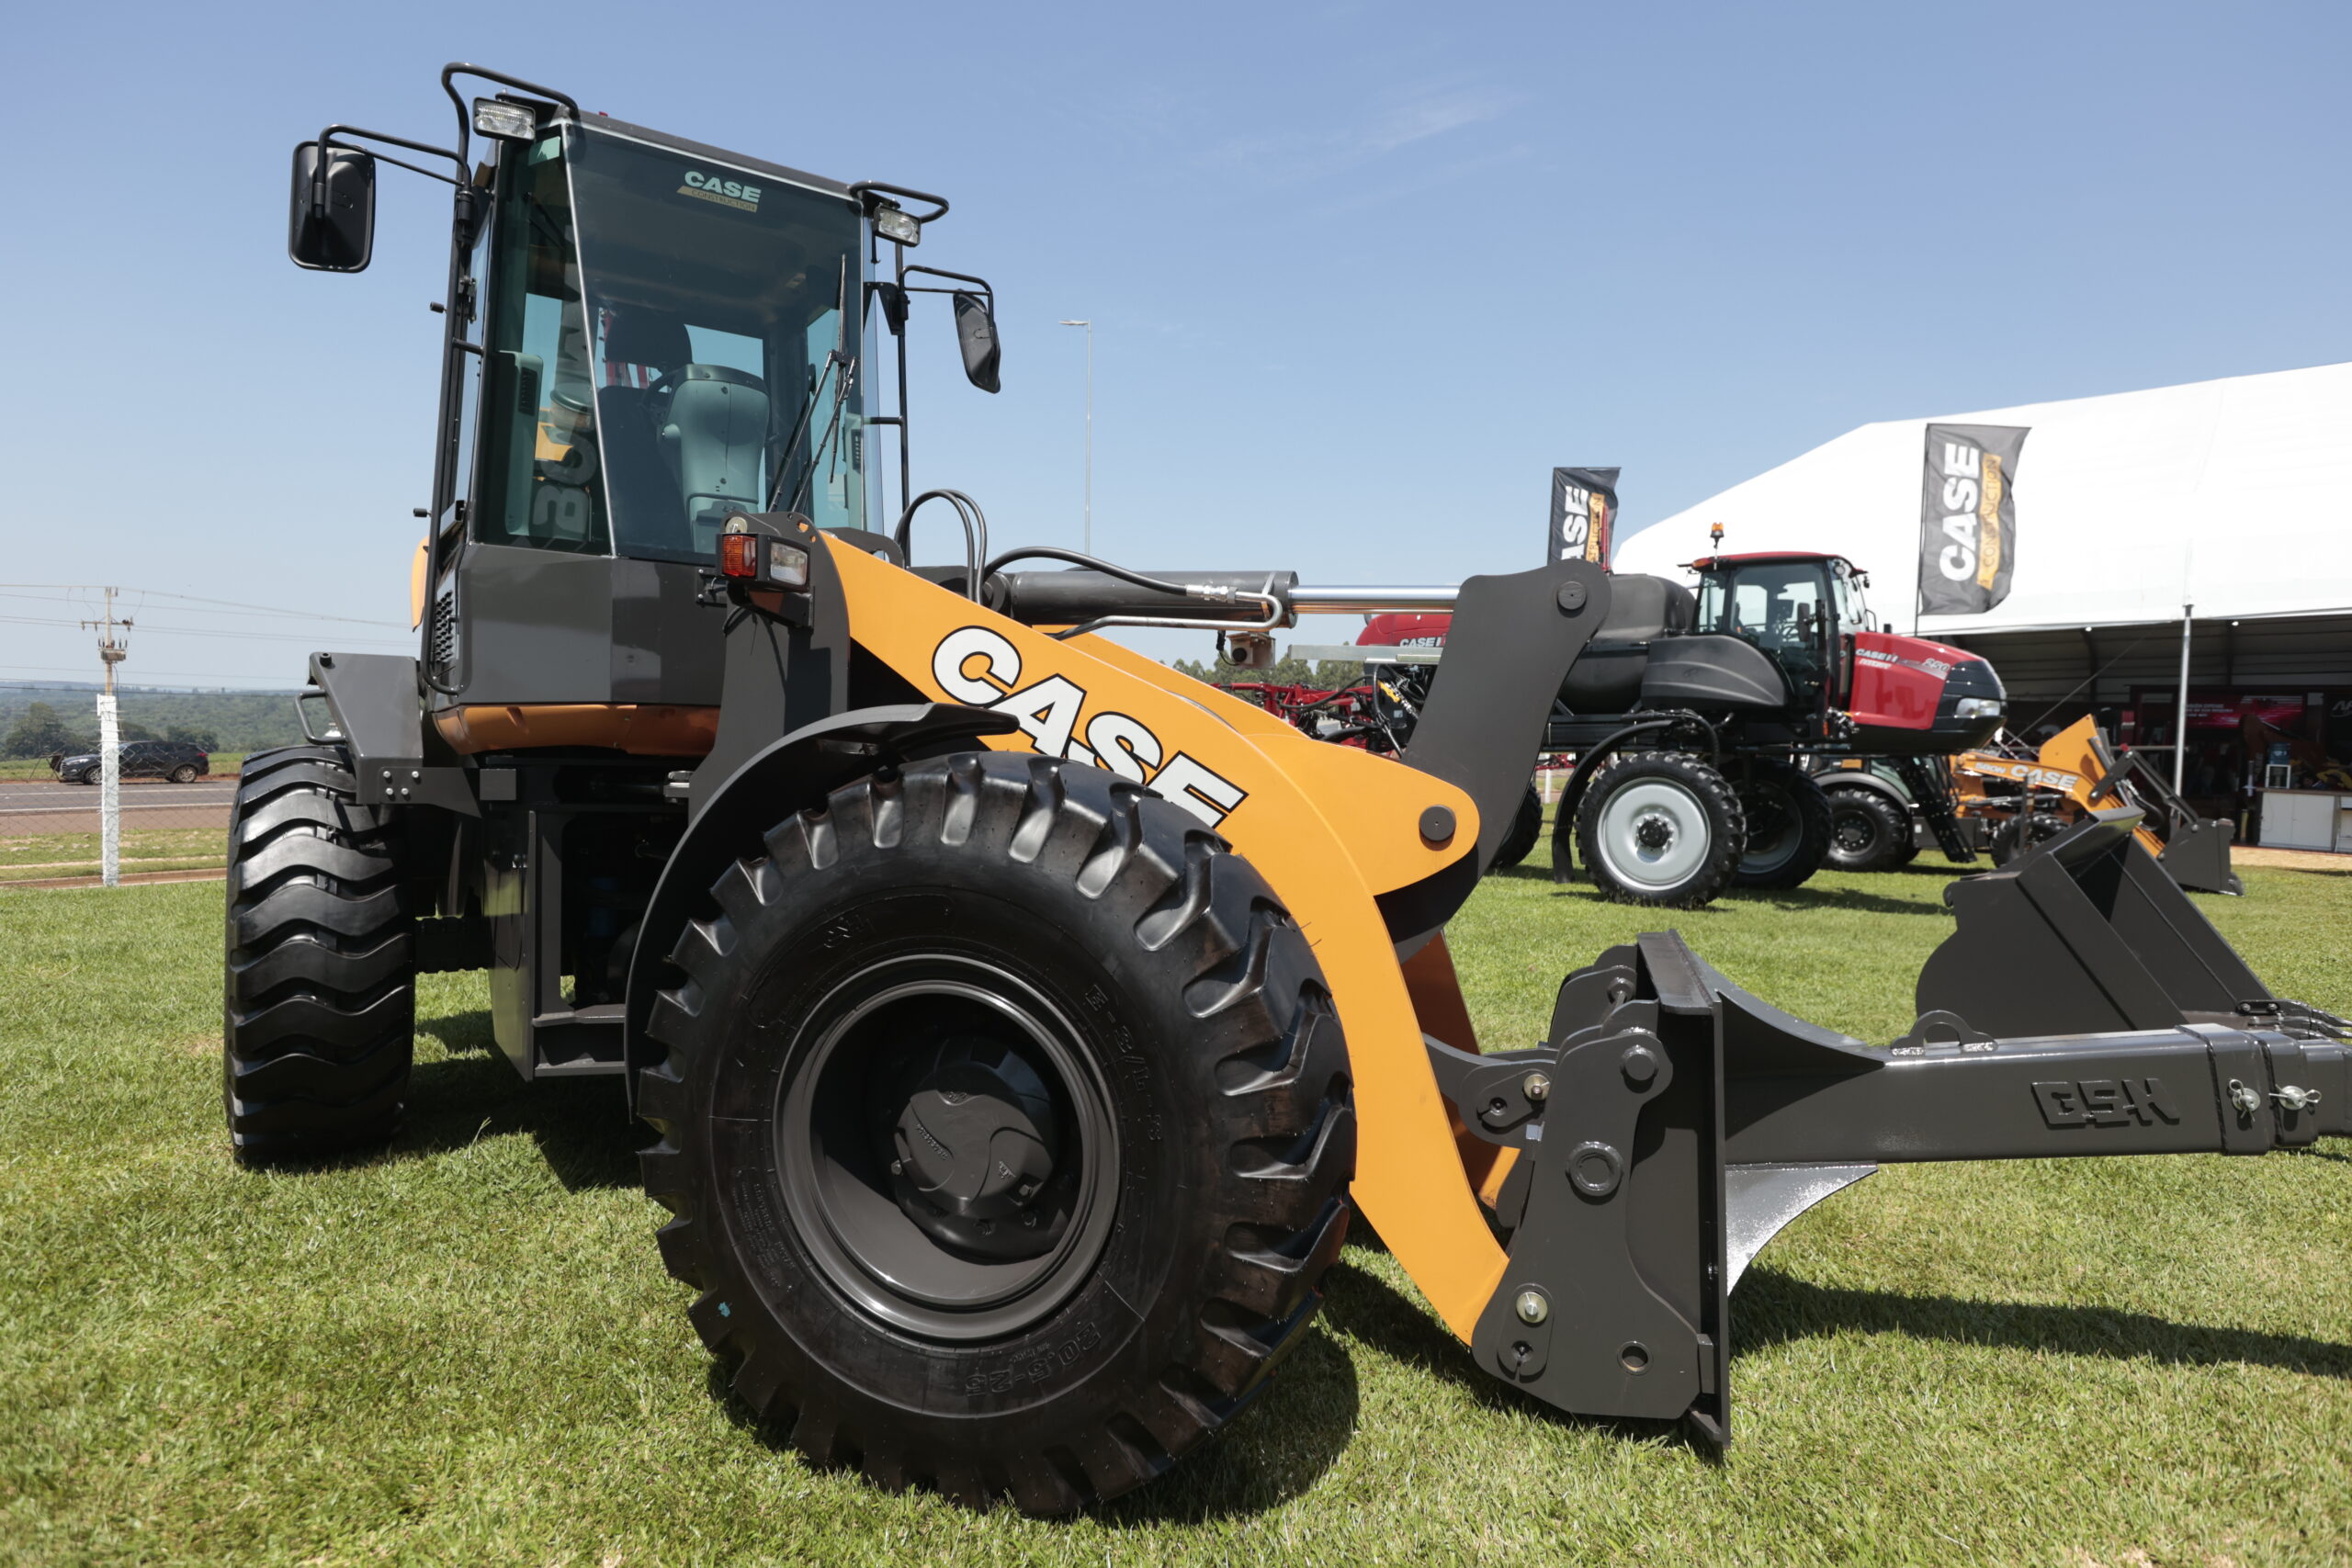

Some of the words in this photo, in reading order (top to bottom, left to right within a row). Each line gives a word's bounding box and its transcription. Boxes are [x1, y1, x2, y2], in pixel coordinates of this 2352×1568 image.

[684, 171, 762, 203] CASE
[691, 189, 756, 210] CONSTRUCTION
[1561, 485, 1589, 560] ASE
[1939, 443, 1980, 581] CASE
[1982, 458, 1999, 568] CONSTRUCTION
[1399, 637, 1436, 648] CASE
[1855, 649, 1886, 661] CASE
[1923, 658, 1951, 672] 250
[932, 625, 1250, 829] CASE
[2010, 764, 2079, 788] CASE
[964, 1321, 1102, 1397] 20.5-25
